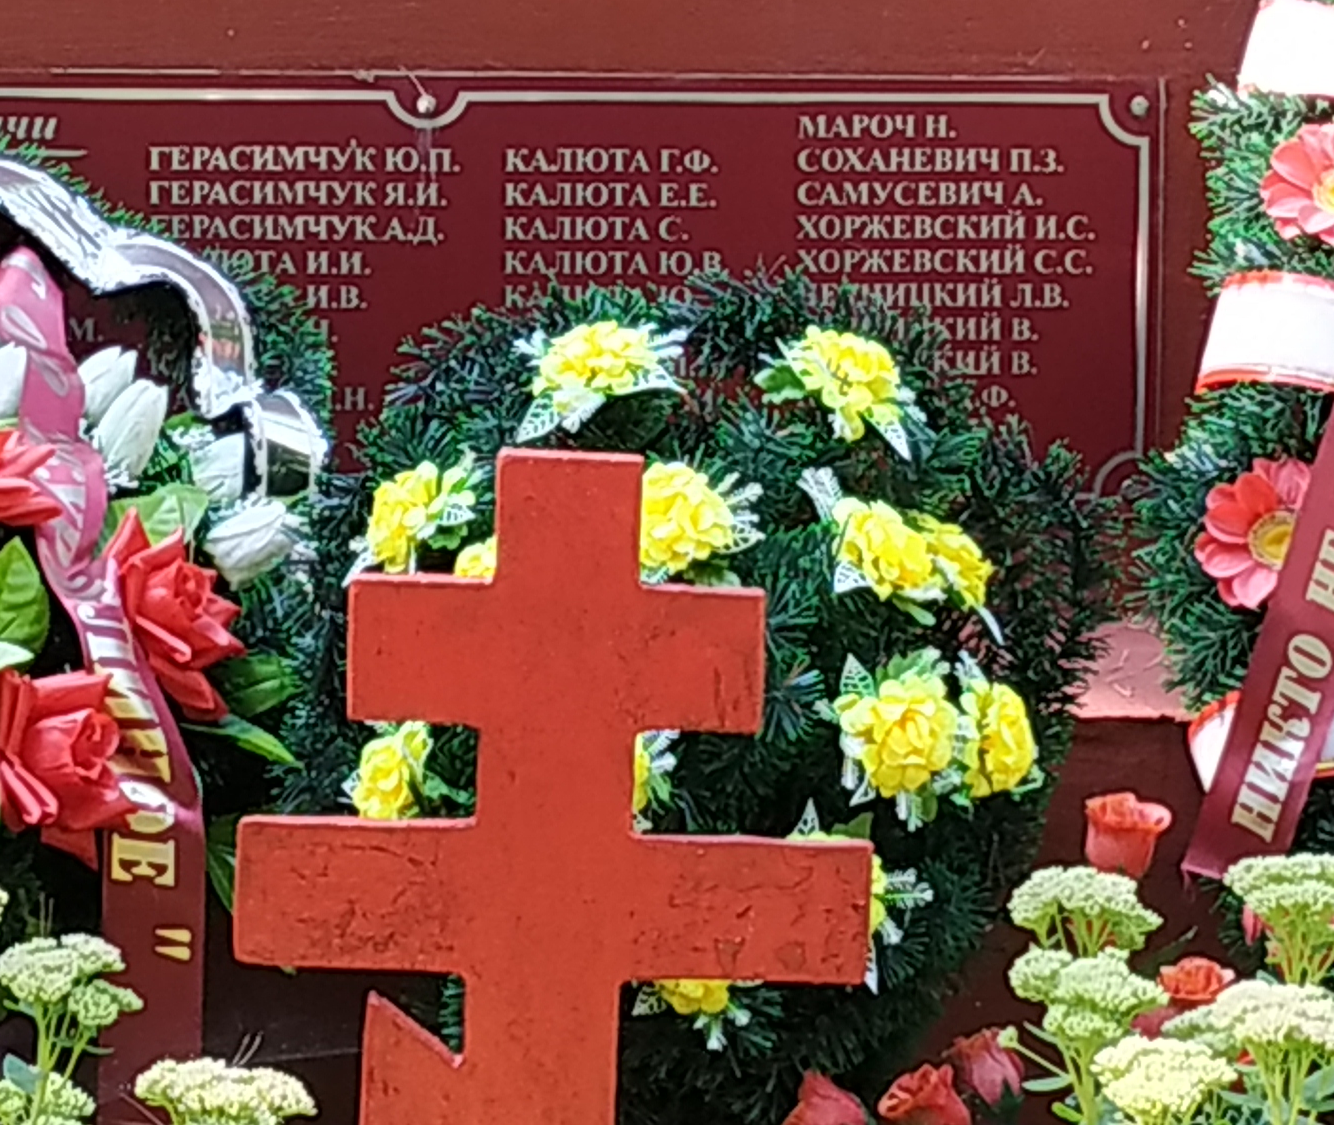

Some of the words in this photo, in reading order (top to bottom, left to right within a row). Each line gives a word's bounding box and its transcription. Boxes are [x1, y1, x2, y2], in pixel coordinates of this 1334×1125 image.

[799, 114, 915, 138] МАРОЧ
[926, 114, 956, 138] Н.
[149, 139, 376, 171] ГЕРАСИМЧУК
[385, 147, 460, 176] Ю.П.
[505, 148, 650, 172] КАЛЮТА
[660, 149, 718, 173] Г.Ф.
[797, 147, 1000, 172] СОХАНЕВИЧ
[1010, 148, 1064, 173] П.З.
[149, 180, 377, 205] ГЕРАСИМЧУК
[384, 182, 447, 206] Я.И.
[505, 182, 650, 207] КАЛЮТА
[660, 183, 716, 207] Е.Е.
[797, 181, 1003, 206] САМУСЕВИЧ
[1013, 183, 1043, 206] А.
[382, 217, 444, 245] А.Д.
[505, 216, 649, 241] КАЛЮТА
[658, 217, 688, 241] С.
[797, 209, 1026, 239] ХОРЖЕВСКИЙ
[1035, 215, 1095, 240] И.С.
[307, 251, 371, 275] И.И.
[504, 250, 648, 275] КАЛЮТА
[795, 244, 1025, 275] ХОРЖЕВСКИЙ
[1034, 249, 1092, 274] С.С.
[305, 285, 367, 309] И.В.
[1010, 283, 1069, 307] Л.В.
[1012, 318, 1038, 341] В.
[1012, 351, 1037, 374] В.
[1230, 632, 1334, 843] НИКТО
